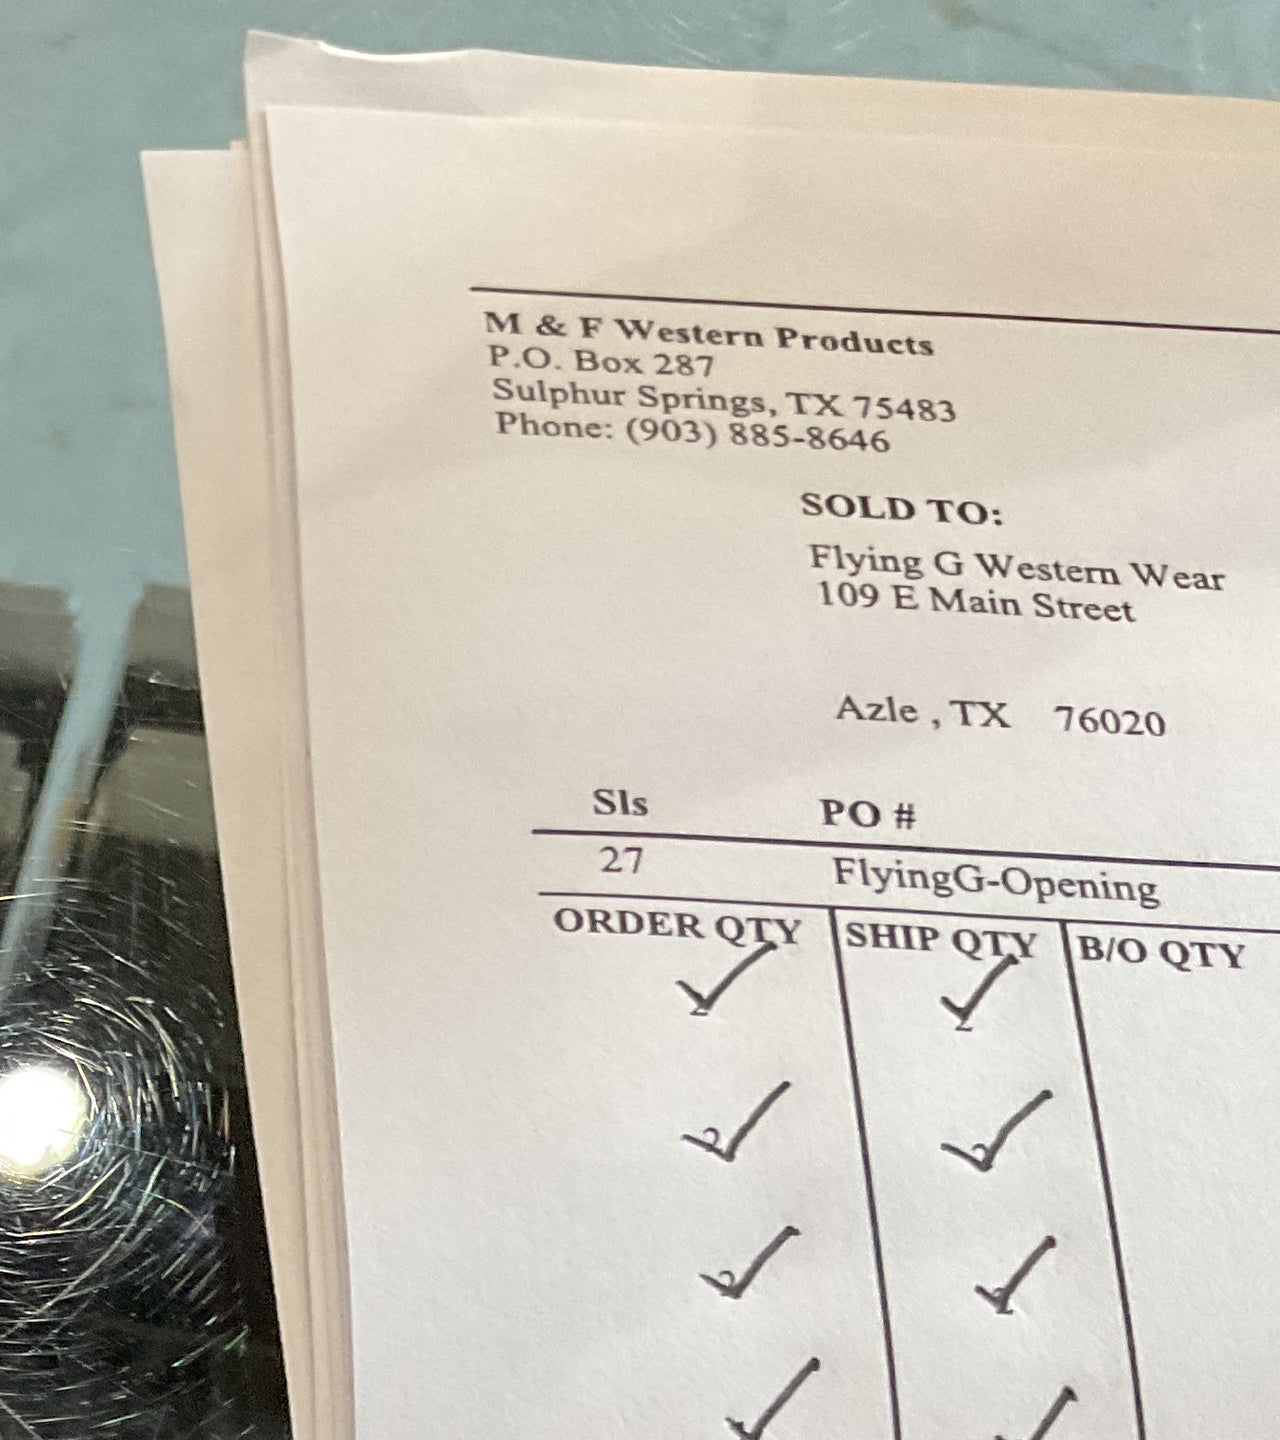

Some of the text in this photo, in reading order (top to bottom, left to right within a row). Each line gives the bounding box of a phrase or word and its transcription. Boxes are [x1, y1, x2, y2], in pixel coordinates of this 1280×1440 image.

[483, 311, 935, 356] M & F Western Products
[488, 344, 714, 378] P.O. Box 287
[492, 377, 956, 423] Sulphur Springs, TX 75483
[494, 410, 891, 453] Phone: (903) 885-8646
[801, 492, 1003, 526] SOLD TO:
[809, 543, 1227, 592] Flying G Western Wear
[819, 580, 1138, 623] 109 E Main Street
[834, 695, 919, 723] Azle
[949, 699, 1013, 729] TX
[1054, 705, 1167, 738] 76020
[592, 788, 649, 817] Sls
[819, 798, 917, 830] PO #
[599, 845, 644, 875] 27
[833, 856, 1161, 910] FlyingG-Opening
[553, 907, 802, 947] ORDER QTY
[845, 921, 1039, 961] SHIP QTY
[1077, 935, 1247, 973] B/O QTY
